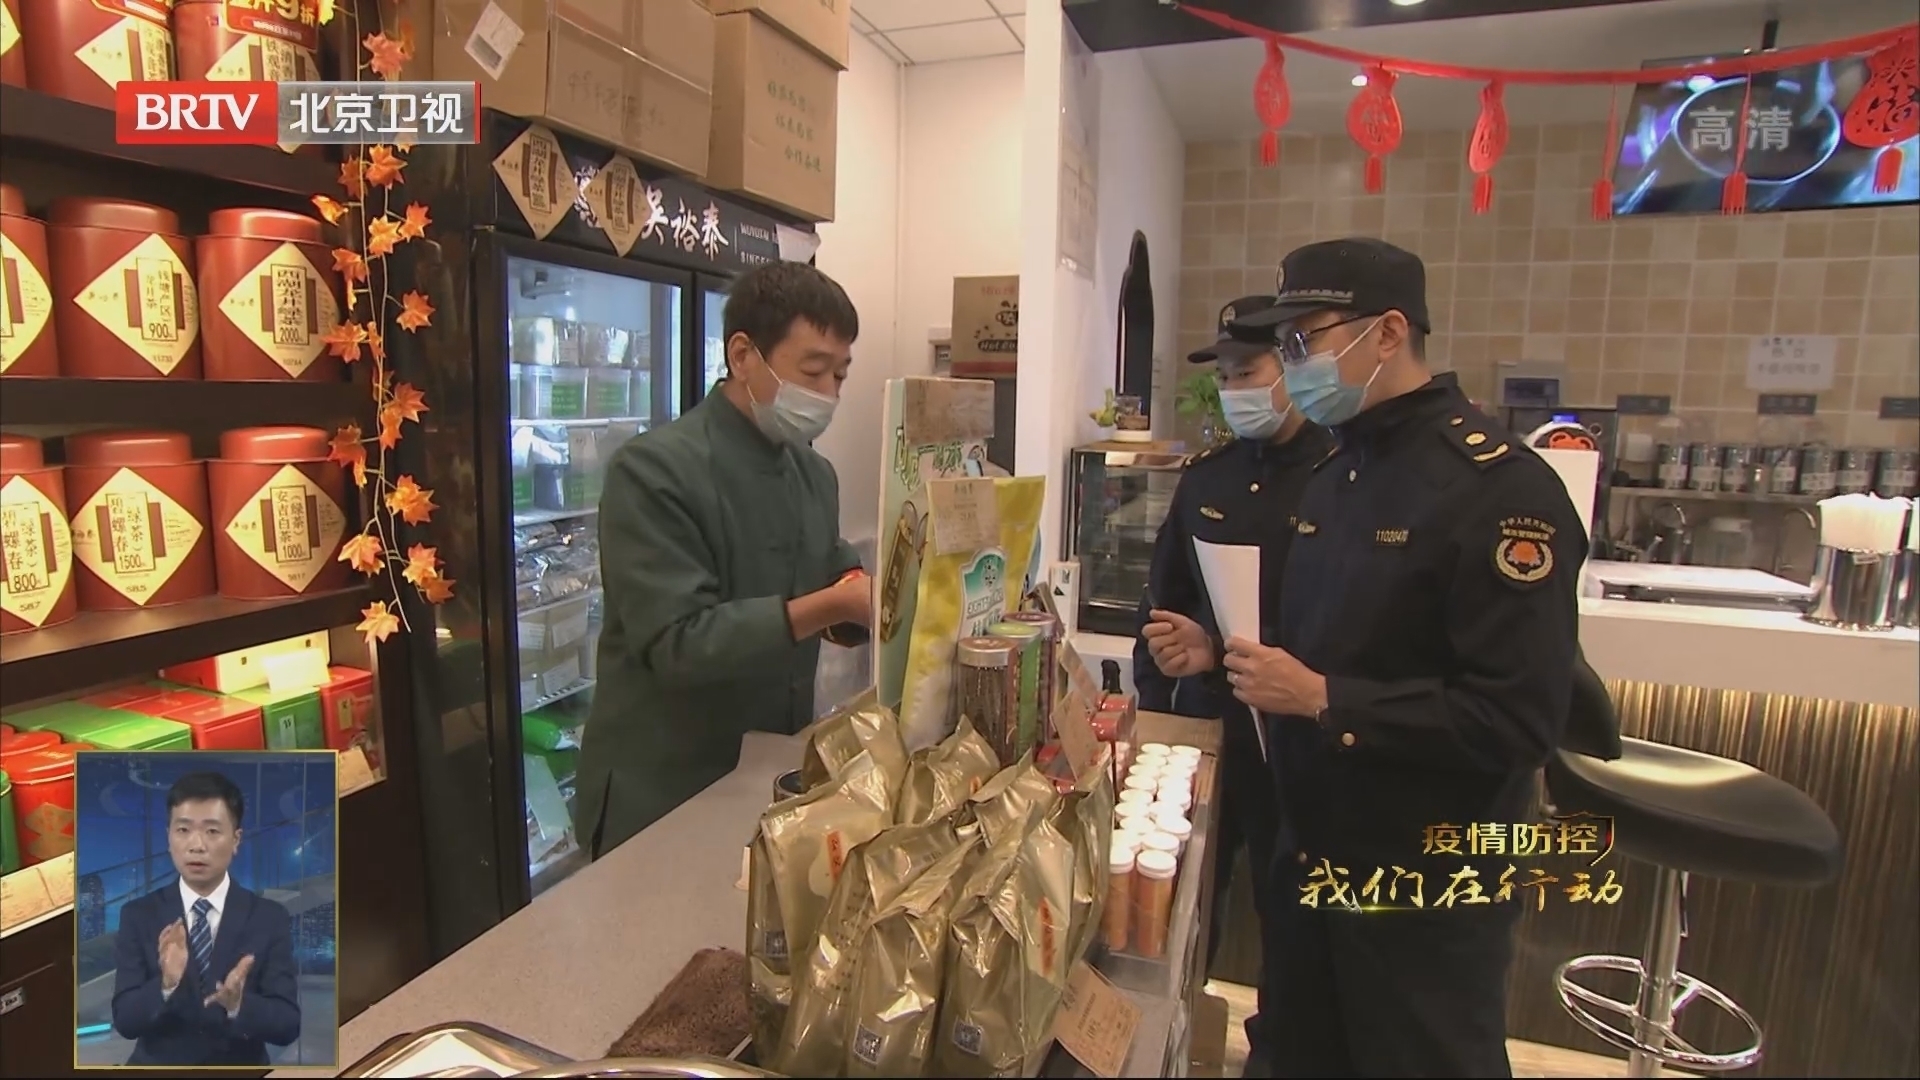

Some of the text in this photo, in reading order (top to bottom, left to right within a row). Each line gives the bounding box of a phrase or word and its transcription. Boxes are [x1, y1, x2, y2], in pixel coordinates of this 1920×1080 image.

[641, 184, 729, 262] 吴裕泰
[149, 322, 169, 338] 900
[279, 326, 300, 342] 2000
[282, 543, 303, 559] 1000
[119, 554, 142, 570] 1500
[13, 572, 38, 592] 800
